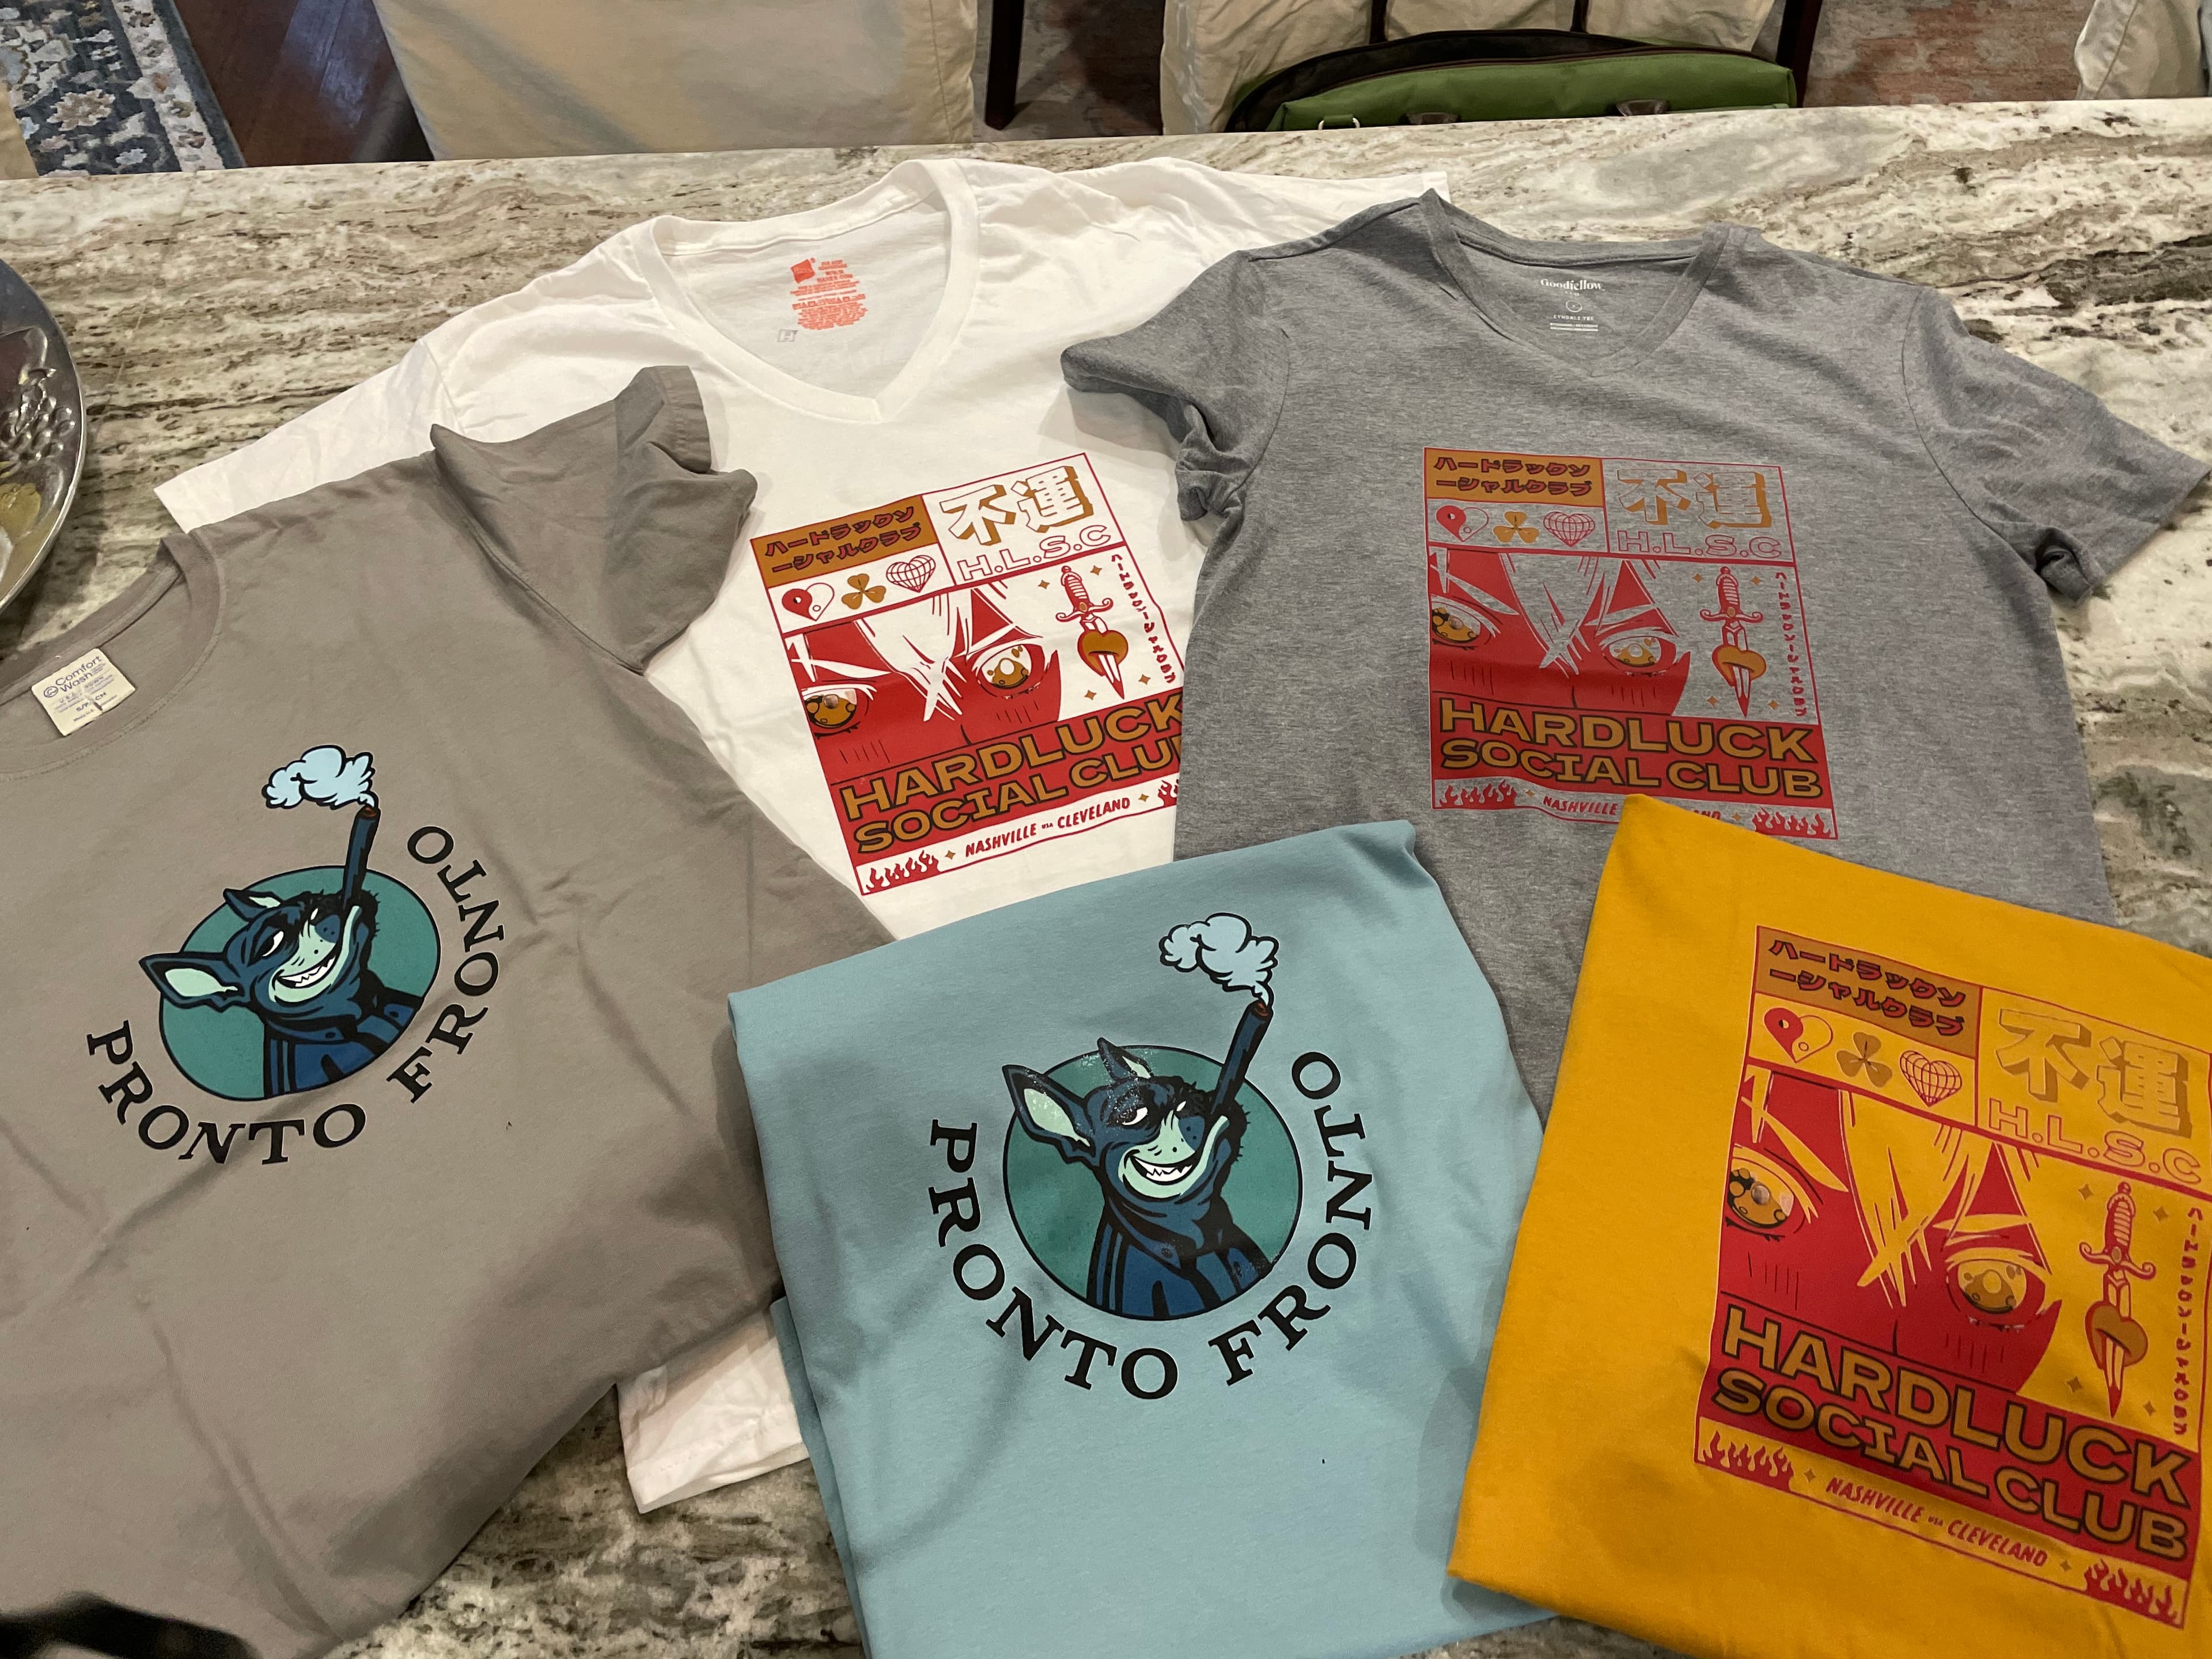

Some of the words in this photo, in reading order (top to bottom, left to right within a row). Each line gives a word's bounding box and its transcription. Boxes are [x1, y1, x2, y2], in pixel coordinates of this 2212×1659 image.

[1540, 278, 1603, 290] Goodfellow
[940, 465, 1094, 546] 不運
[1616, 469, 1772, 529] 不運
[957, 525, 1111, 581] H.L.S.C
[1617, 529, 1782, 559] H.L.S.C
[55, 656, 102, 685] Comfort
[59, 672, 93, 692] Wash
[839, 691, 1183, 822] HARDLUCK
[1440, 696, 1819, 763] HARDLUCK
[1439, 738, 1662, 787] SOCIAL
[1667, 762, 1824, 798] CLUB
[853, 774, 1069, 854] SOCIAL
[965, 823, 1037, 858] NASHVILLE
[1041, 821, 1054, 830] USA
[1057, 797, 1131, 829] CLEVELAND
[1543, 796, 1619, 816] NASHVILLE
[86, 1020, 366, 1165] PRONTO
[387, 825, 505, 1104] FRONTO
[1995, 1008, 2192, 1139] 不運
[1988, 1097, 2202, 1184] H.L.S.C
[928, 1119, 1178, 1400] PRONTO
[1207, 1051, 1373, 1387] FRONTO
[1721, 1304, 2192, 1510] HARDLUCK
[1712, 1368, 1990, 1498] SOCIAL
[1994, 1465, 2188, 1562] CLUB
[1825, 1476, 1926, 1523] NASHVILLE
[1946, 1520, 2048, 1567] CLEVELAND
